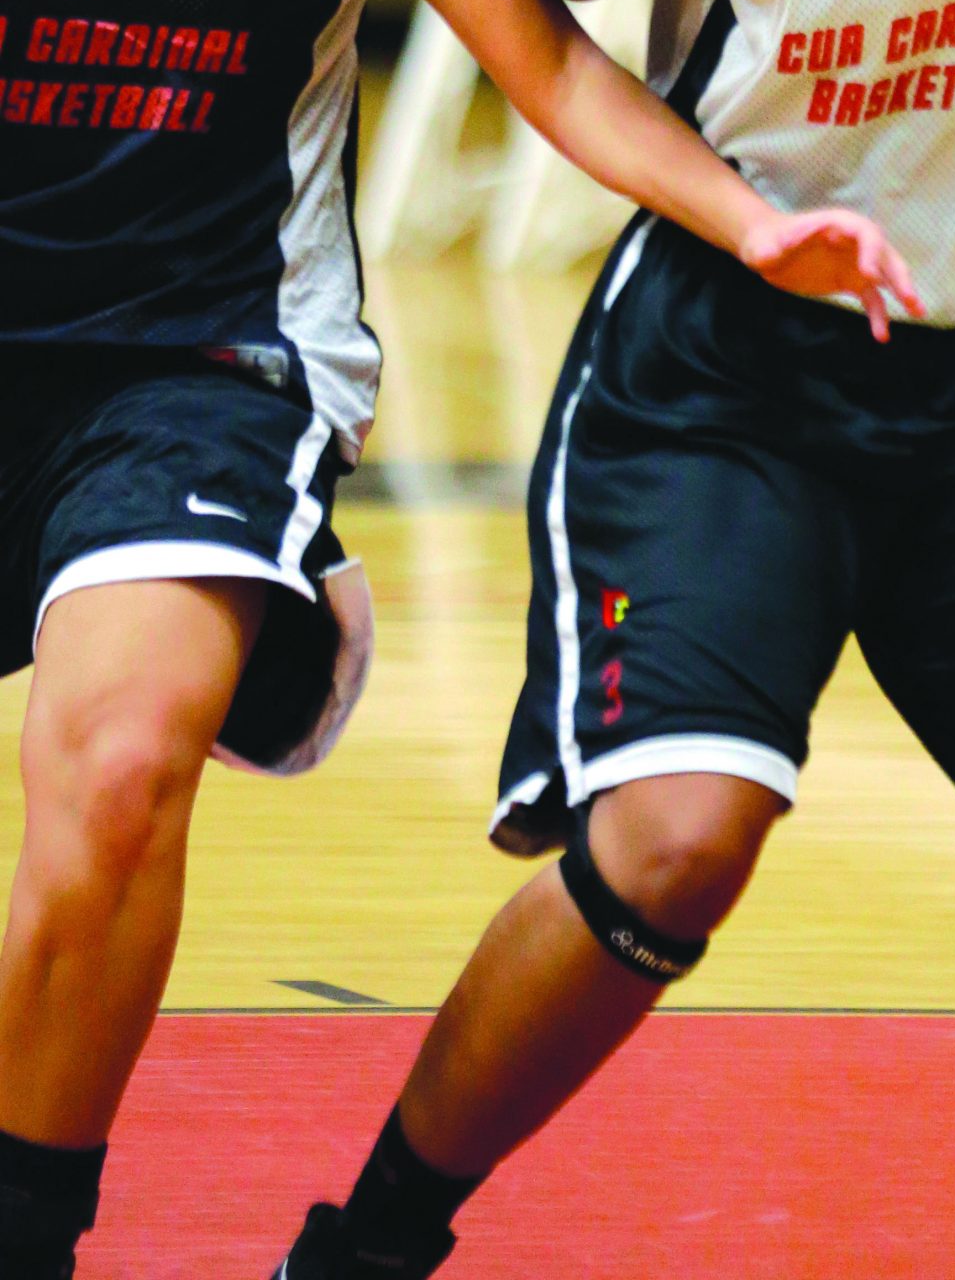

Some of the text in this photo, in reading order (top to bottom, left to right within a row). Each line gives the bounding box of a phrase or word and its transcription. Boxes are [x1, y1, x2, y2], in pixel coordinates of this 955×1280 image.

[26, 17, 249, 74] CARDINAL
[777, 23, 865, 74] CUA
[0, 78, 215, 132] SKETBALL
